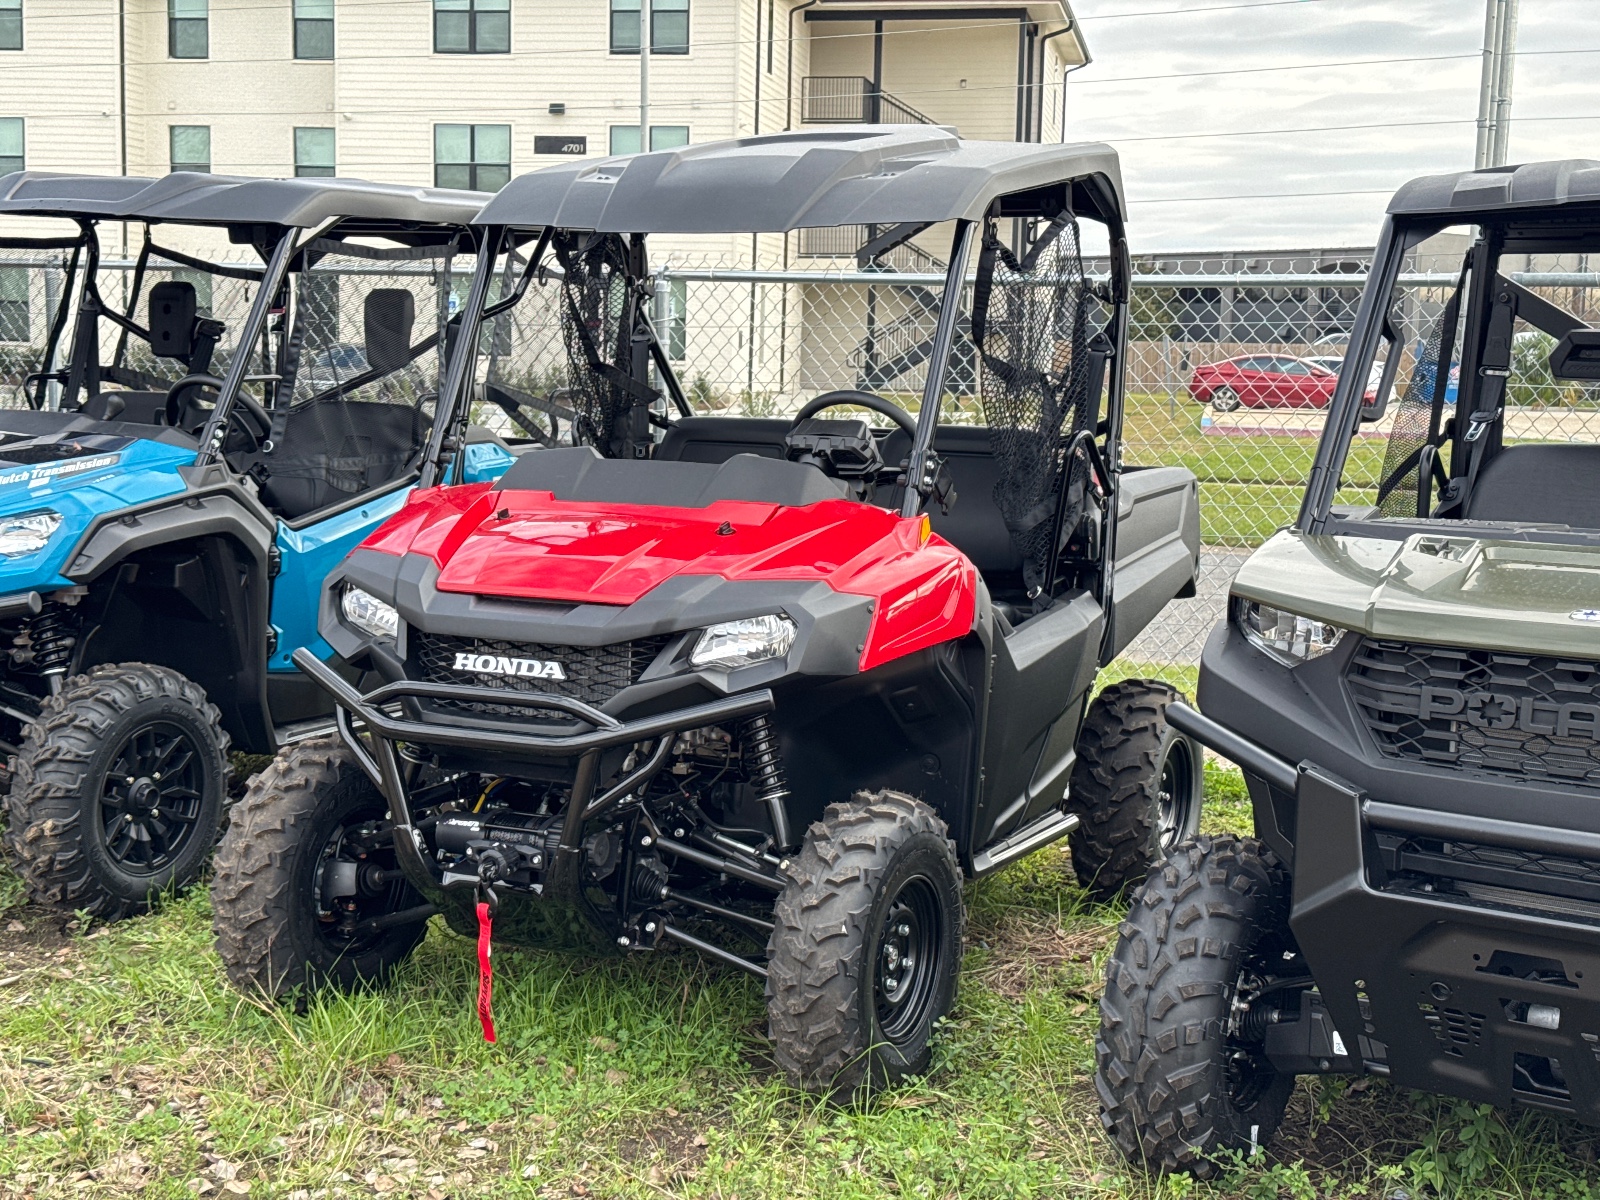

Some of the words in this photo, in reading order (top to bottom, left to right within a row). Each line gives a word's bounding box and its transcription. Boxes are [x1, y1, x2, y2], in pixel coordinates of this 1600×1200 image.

[561, 143, 584, 153] 4701
[31, 457, 112, 479] Transmission
[452, 652, 568, 680] HONDA
